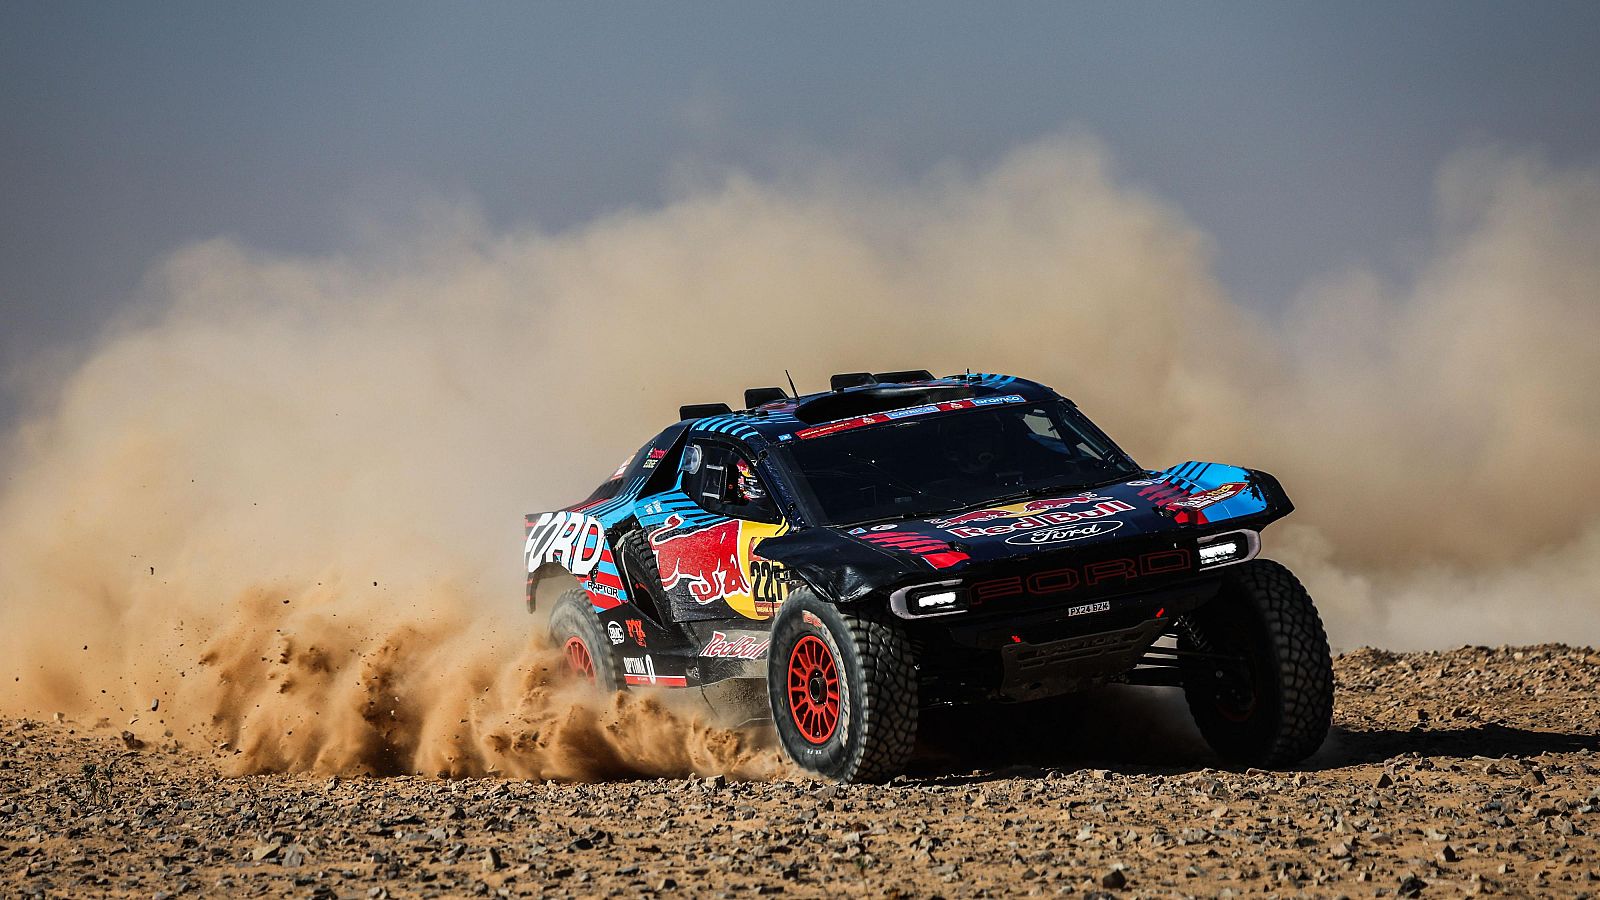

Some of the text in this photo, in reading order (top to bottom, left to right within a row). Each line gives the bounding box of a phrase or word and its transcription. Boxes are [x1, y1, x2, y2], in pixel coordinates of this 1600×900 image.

[946, 500, 1137, 539] Red Bull
[1030, 523, 1101, 542] Ford
[524, 511, 605, 575] FORD
[587, 581, 619, 598] RAPTOR
[969, 549, 1192, 605] FORD
[699, 631, 744, 659] Red
